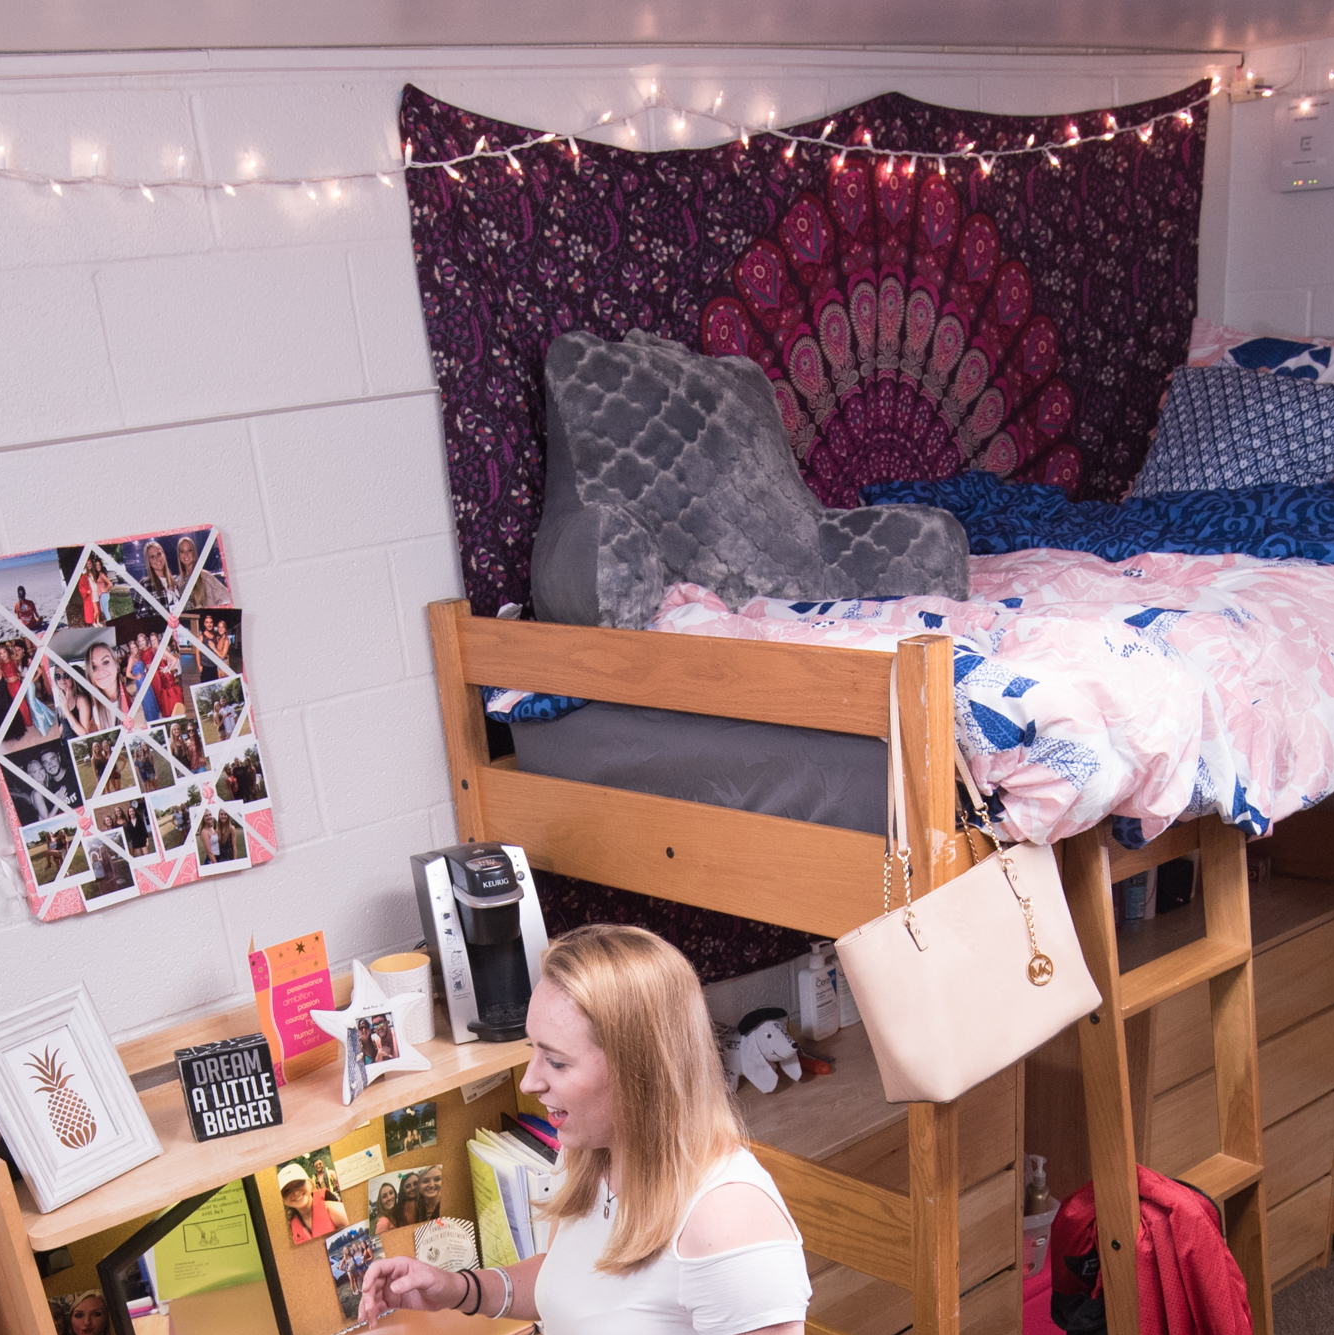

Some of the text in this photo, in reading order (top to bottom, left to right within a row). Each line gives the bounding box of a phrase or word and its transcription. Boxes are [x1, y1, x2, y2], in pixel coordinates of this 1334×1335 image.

[482, 877, 510, 889] KEURIG
[273, 958, 300, 973] Success
[286, 976, 324, 996] perseverance
[282, 989, 315, 1007] ambition
[297, 997, 321, 1012] passion
[284, 1011, 309, 1026] courage
[293, 1027, 315, 1041] humor
[191, 1048, 263, 1087] DREAM
[191, 1072, 275, 1113] A LITTLE
[202, 1098, 274, 1137] BIGGER
